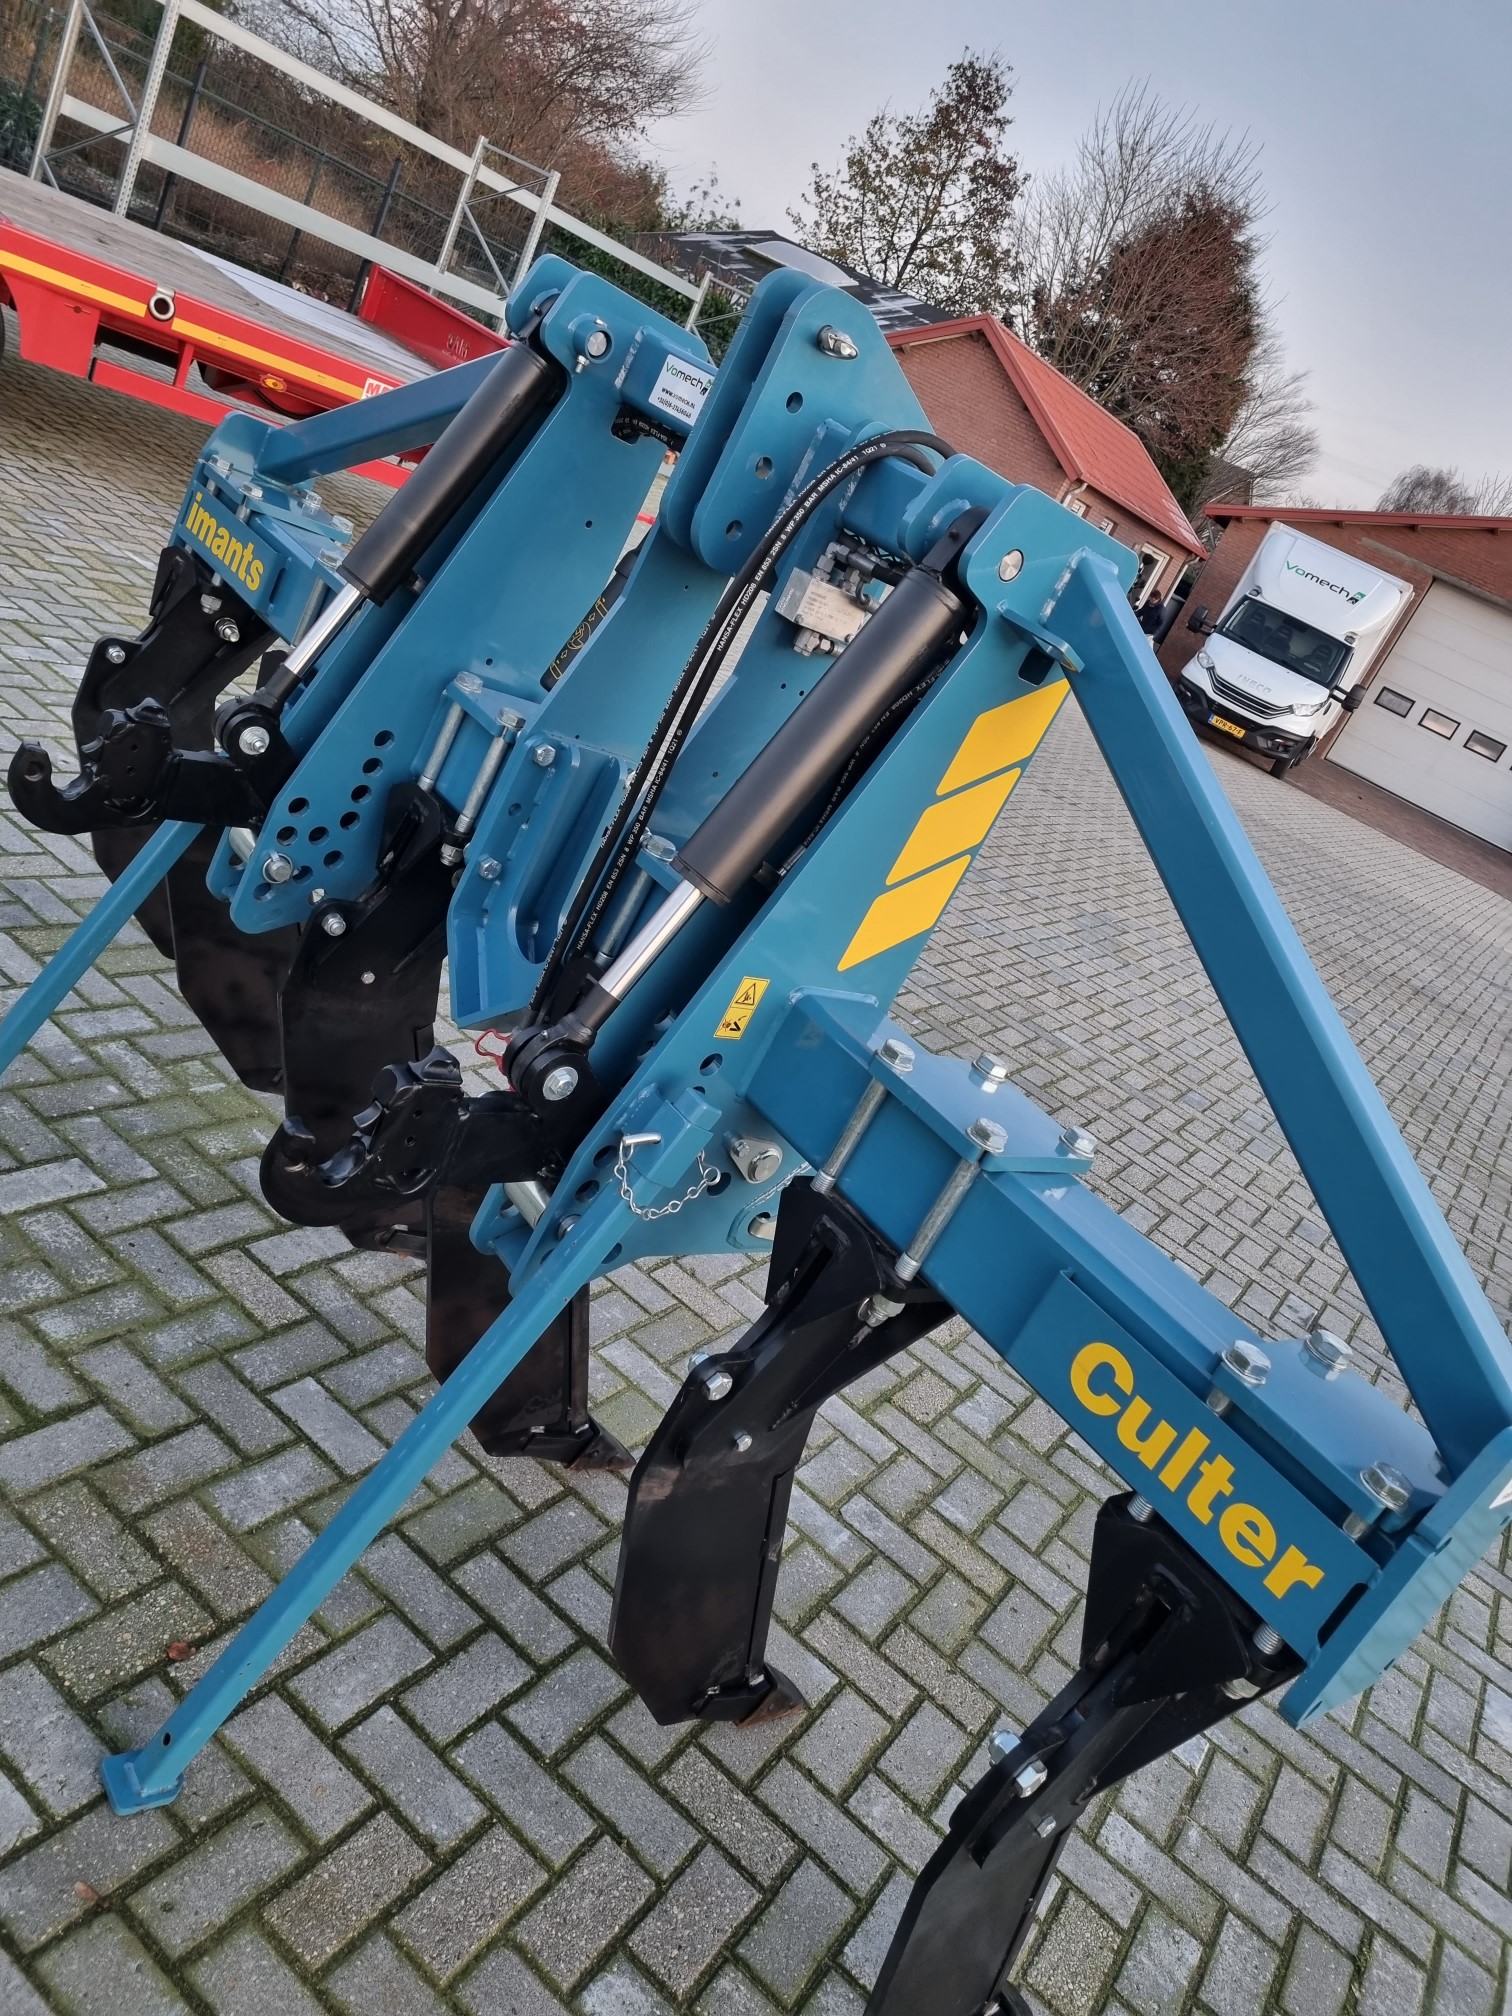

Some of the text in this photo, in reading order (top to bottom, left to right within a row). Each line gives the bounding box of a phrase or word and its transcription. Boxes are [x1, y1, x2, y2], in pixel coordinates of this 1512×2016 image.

[665, 361, 704, 390] Vomech
[661, 386, 696, 409] www.vomech.nl
[185, 492, 264, 591] imants
[717, 607, 743, 652] HANSA-FLEX
[755, 569, 764, 581] EN
[762, 557, 772, 570] 853
[770, 540, 782, 556] 2SN
[784, 520, 796, 533] WP
[794, 508, 805, 522] 350
[804, 492, 818, 508] BAR
[817, 474, 837, 492] MSHA
[834, 455, 860, 476] IC-84/41
[862, 445, 878, 456] 1Q21
[1286, 560, 1350, 599] Vomech
[1237, 673, 1273, 694] IVECO
[1214, 717, 1244, 737] VPR-67-F
[576, 912, 598, 950] HANSA-FLEX
[595, 890, 608, 911] HD208
[606, 880, 614, 890] EN
[610, 868, 620, 880] 853
[616, 853, 627, 867] 2SN
[626, 836, 636, 846] WP
[638, 806, 648, 821] BAR
[646, 784, 658, 804] MSHA
[655, 759, 669, 785] IC-84/41
[667, 738, 678, 755] 1Q21
[1070, 1342, 1325, 1599] Culter
